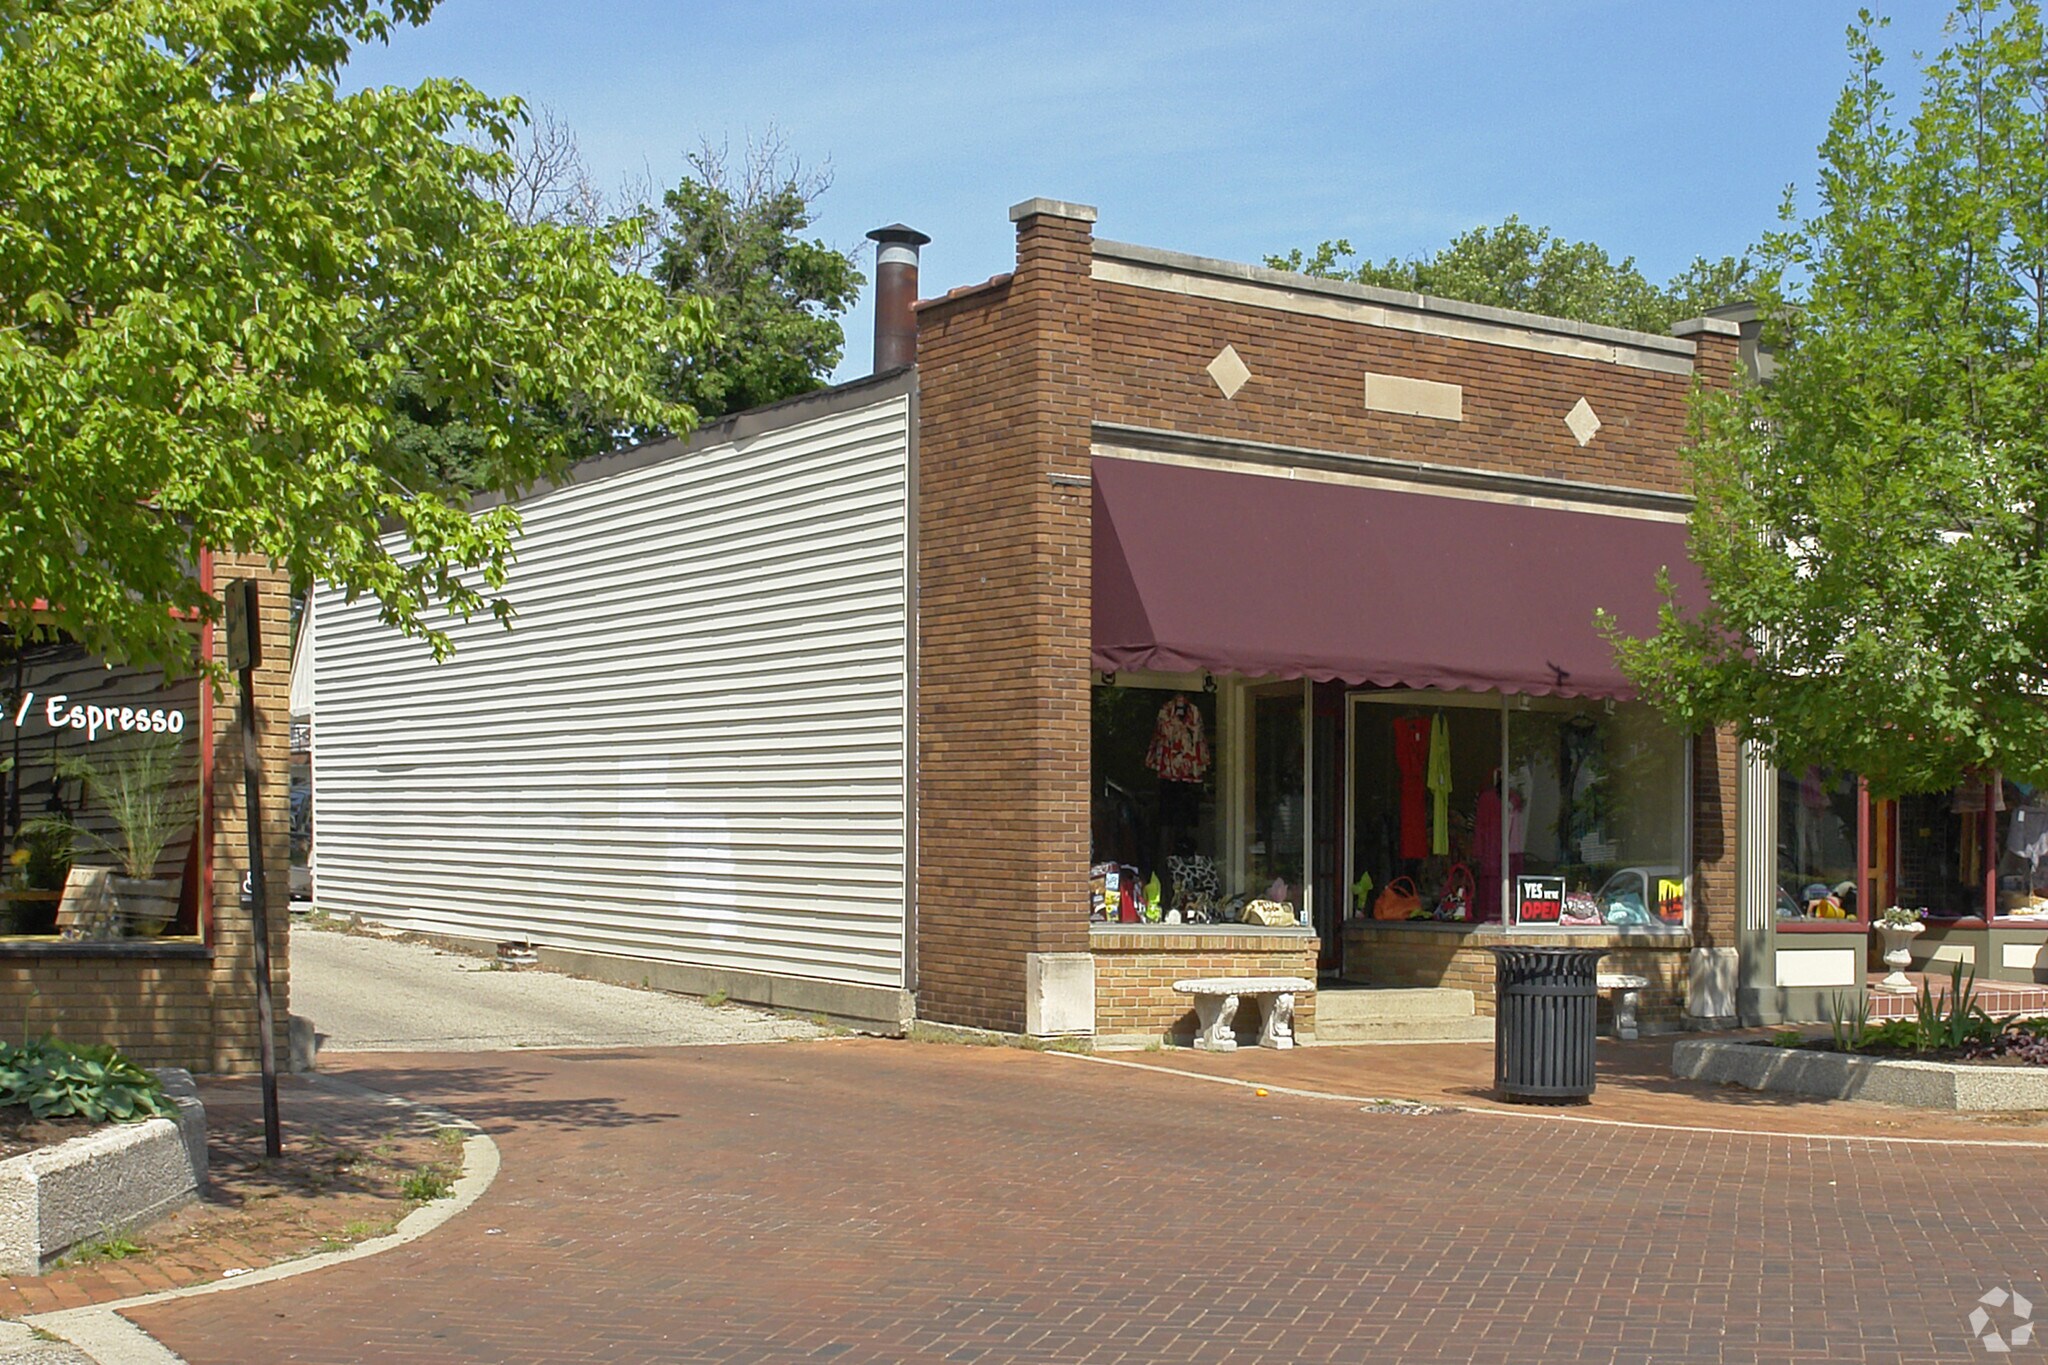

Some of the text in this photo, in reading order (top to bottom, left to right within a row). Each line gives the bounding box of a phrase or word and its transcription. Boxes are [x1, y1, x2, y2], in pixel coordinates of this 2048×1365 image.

[46, 695, 184, 741] Espresso
[1524, 883, 1543, 899] YES
[1521, 901, 1560, 920] OPEN
